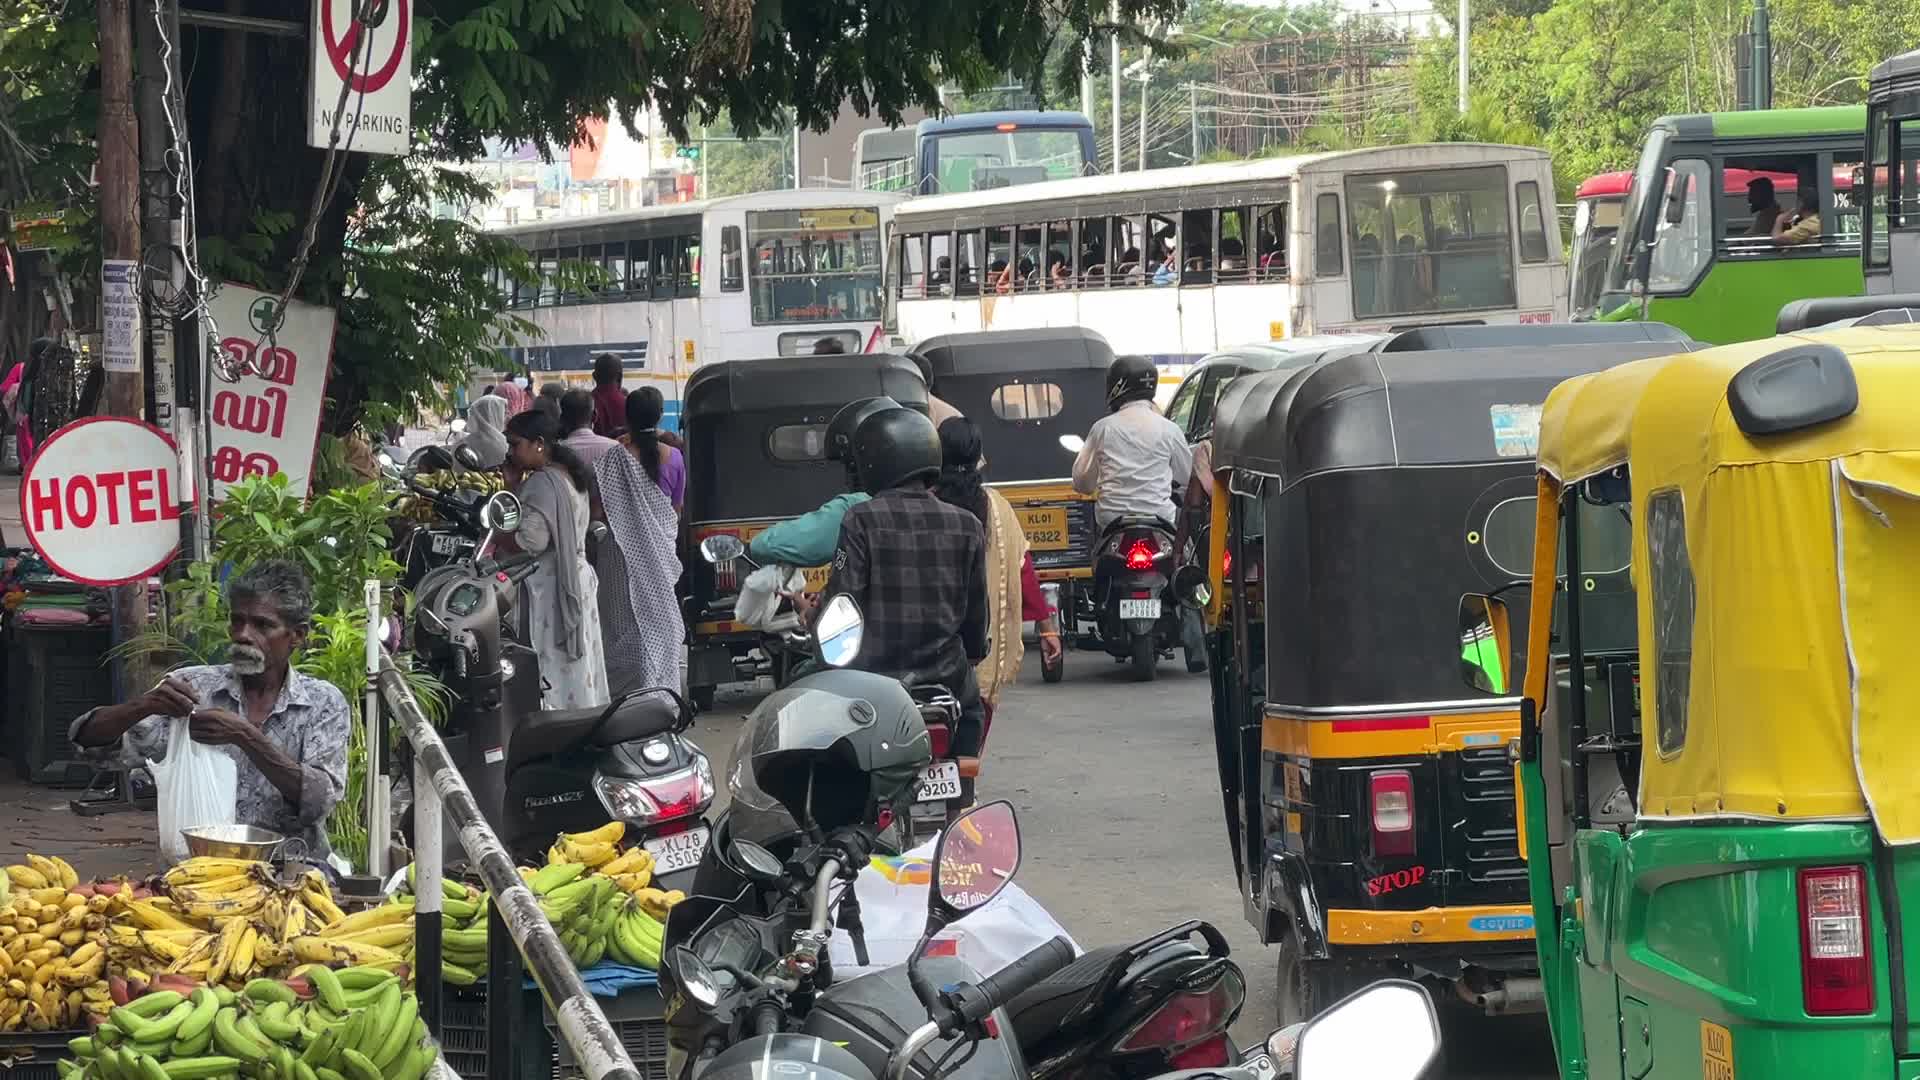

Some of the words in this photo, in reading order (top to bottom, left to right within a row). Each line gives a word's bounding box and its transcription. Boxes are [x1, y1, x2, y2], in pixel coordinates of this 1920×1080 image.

[30, 468, 180, 532] HOTEL
[1028, 514, 1051, 524] KL01
[1026, 530, 1061, 543] F6322
[920, 782, 956, 797] .9203
[1367, 865, 1425, 896] STOP
